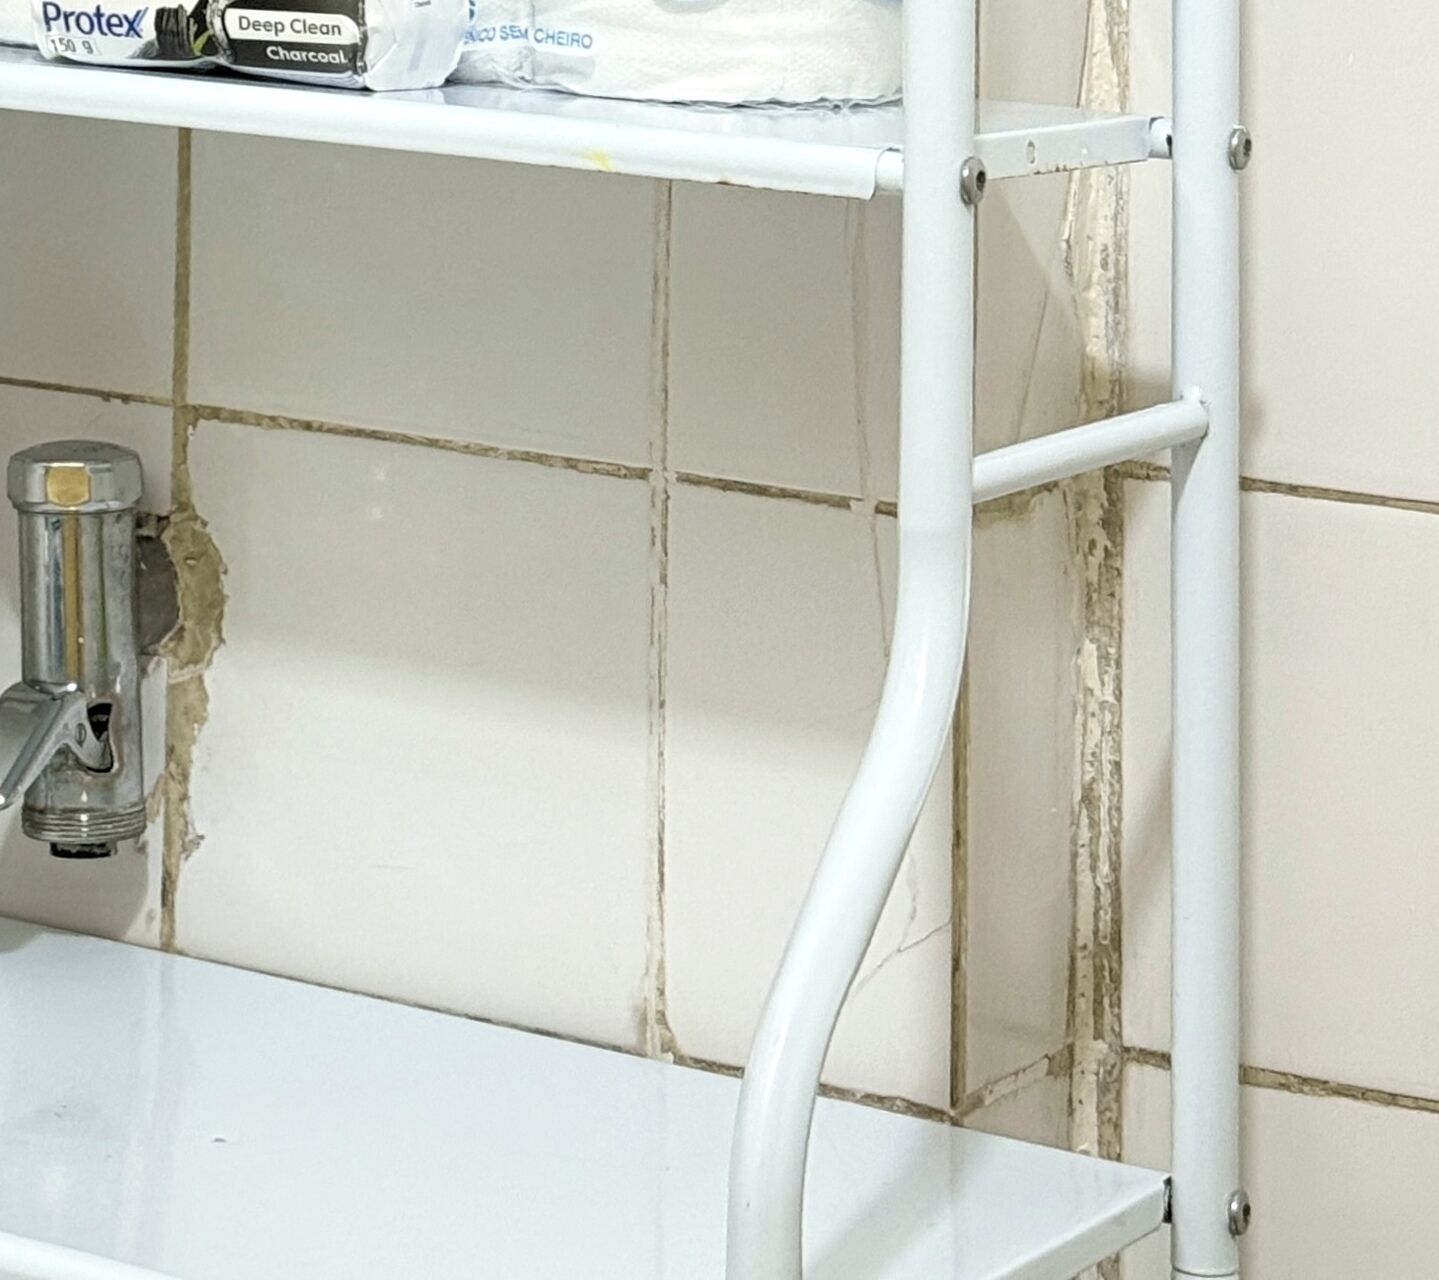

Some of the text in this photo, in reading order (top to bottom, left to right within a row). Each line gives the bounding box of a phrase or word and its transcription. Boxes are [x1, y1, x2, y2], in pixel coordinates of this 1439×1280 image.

[42, 1, 149, 39] Protex
[238, 15, 342, 37] Deep Clean
[50, 38, 94, 54] 150 g
[499, 24, 529, 40] SEM
[534, 28, 593, 49] CHEIRO
[266, 46, 348, 65] Charcoal
